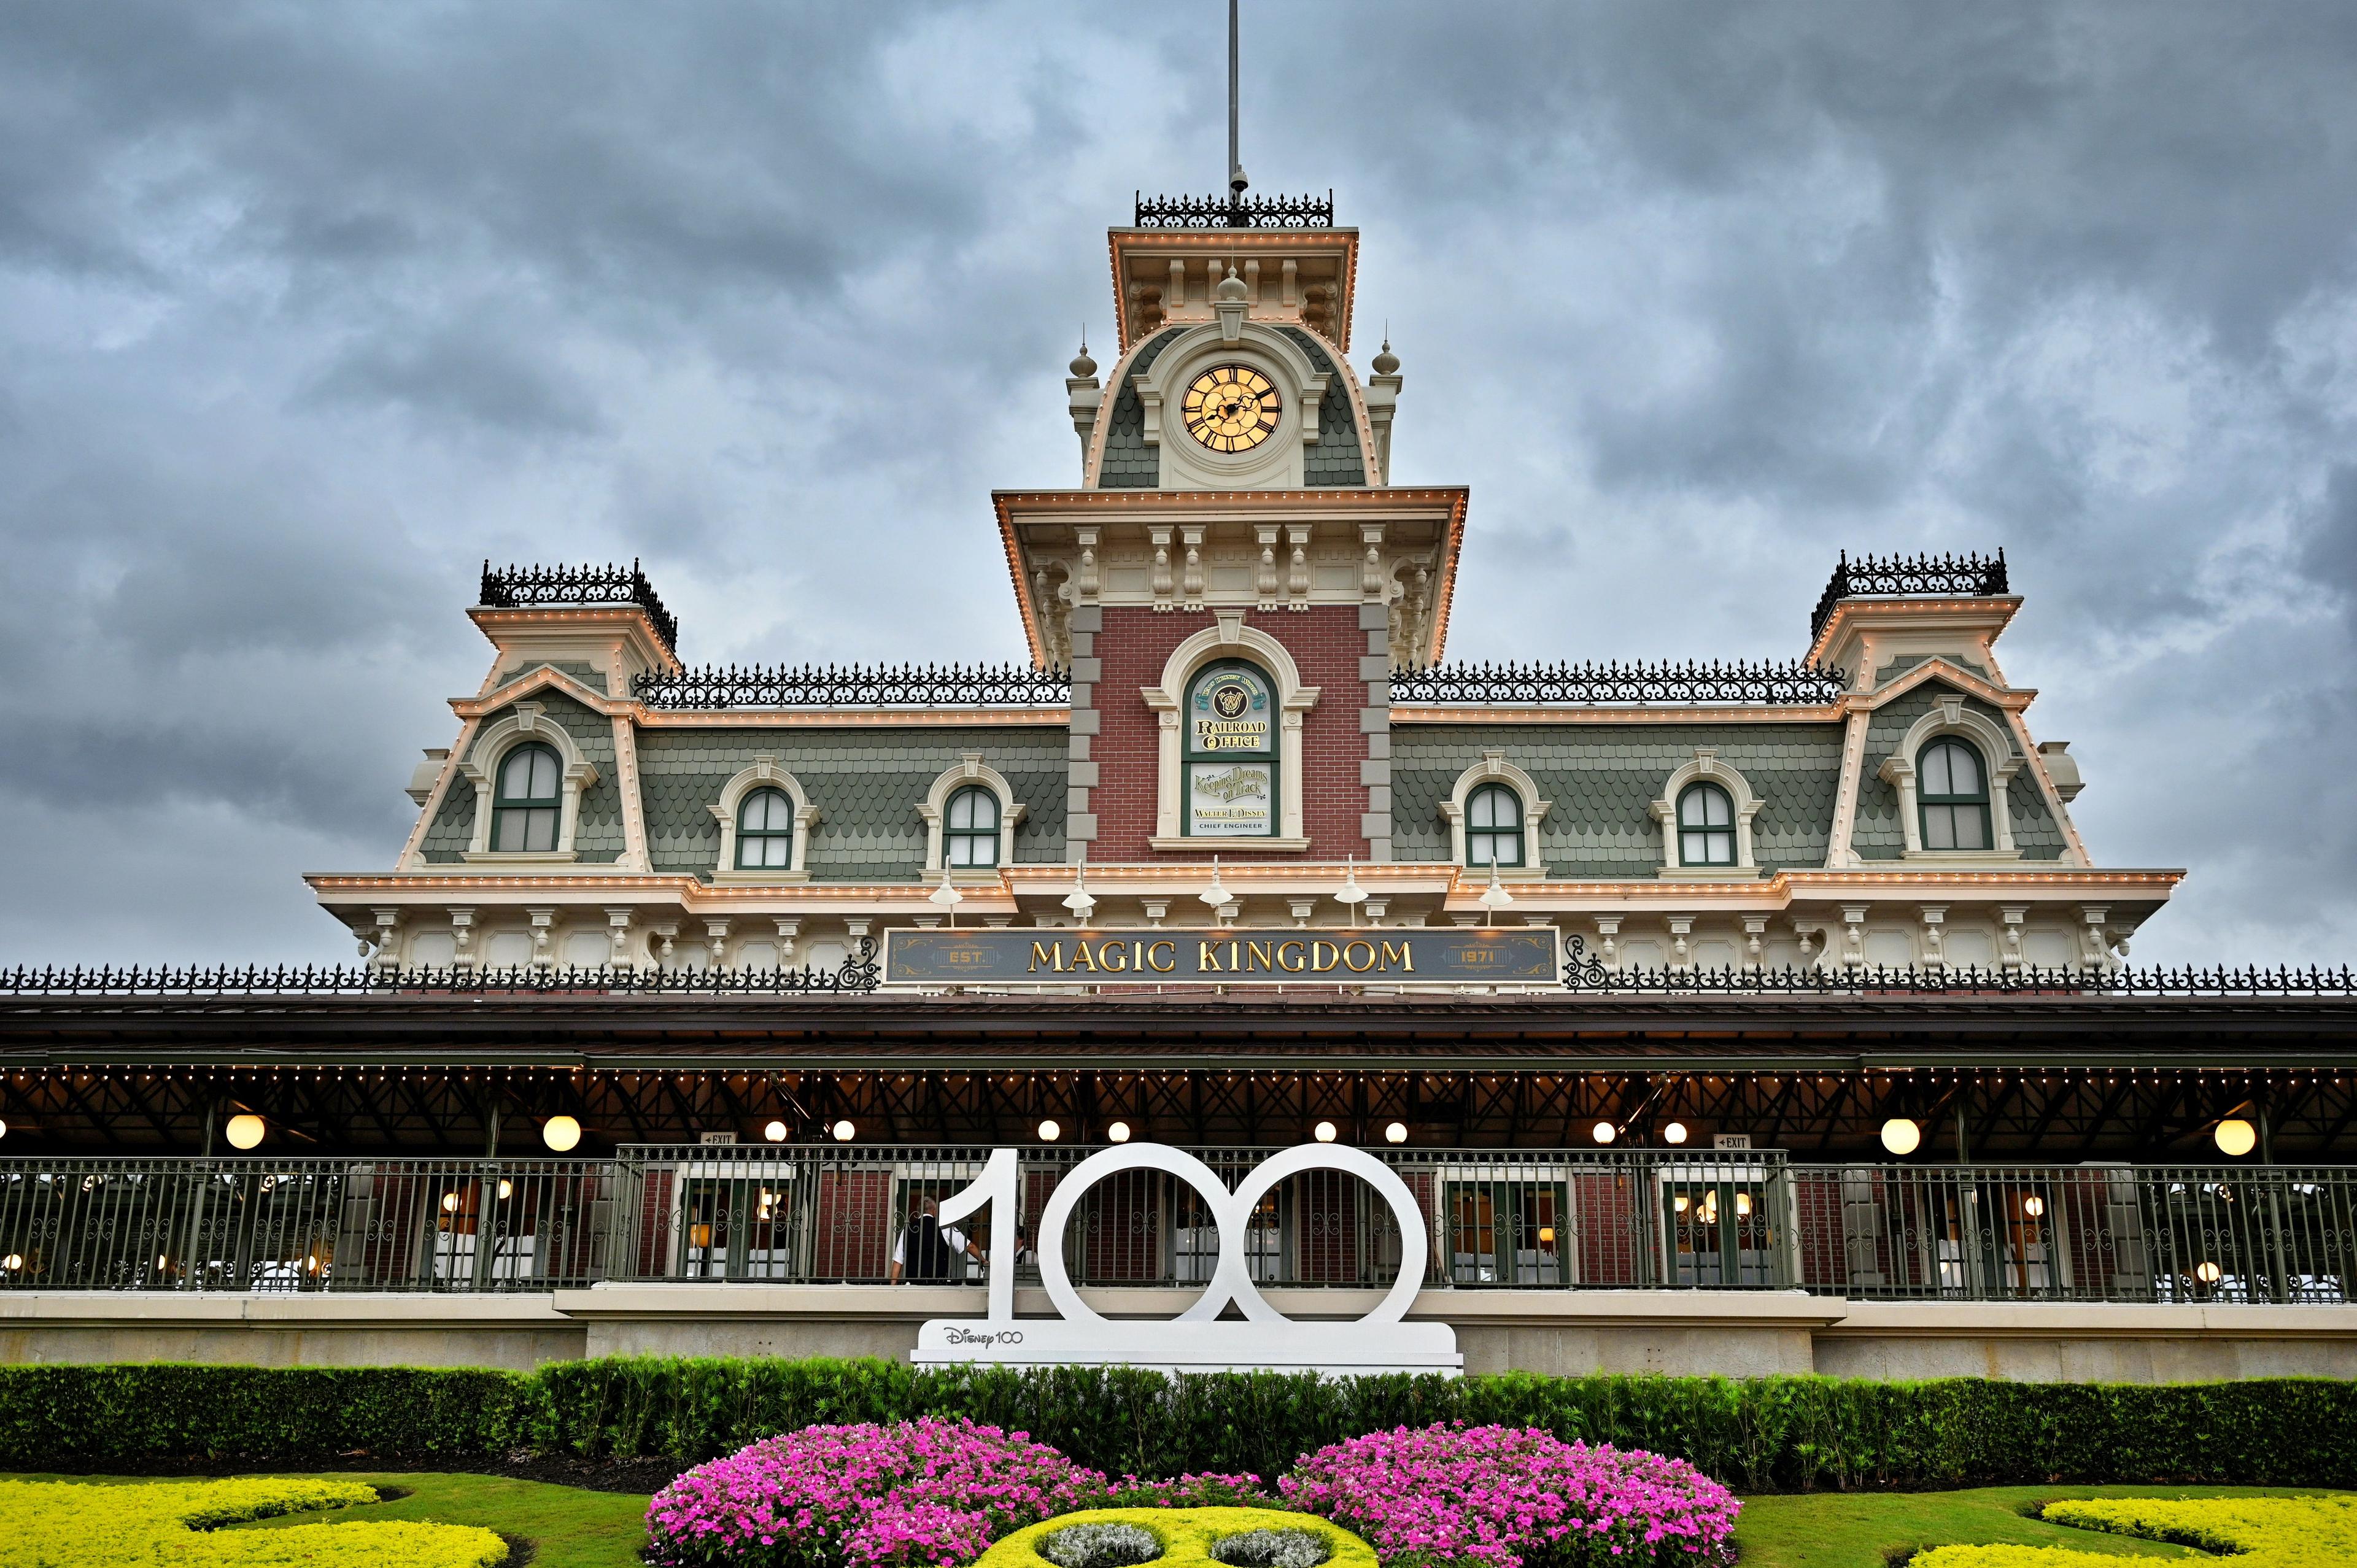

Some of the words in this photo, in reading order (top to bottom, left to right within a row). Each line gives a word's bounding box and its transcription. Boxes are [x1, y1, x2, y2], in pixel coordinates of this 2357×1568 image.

[1196, 720, 1266, 735] RAILROAD
[1202, 735, 1260, 750] OFFICE
[1194, 774, 1232, 797] Keeping
[1232, 766, 1268, 784] Dreams
[1223, 789, 1233, 800] on
[1233, 781, 1263, 795] Track
[1194, 809, 1227, 818] WALTER
[1237, 808, 1266, 818] DISNEY
[950, 951, 986, 963] EST.
[1027, 940, 1175, 972] MAGIC
[1197, 940, 1415, 972] KINGDOM
[1461, 951, 1494, 963] 1971
[713, 1135, 732, 1144] EXIT
[1726, 1137, 1746, 1148] EXIT
[939, 1142, 1428, 1322] 100
